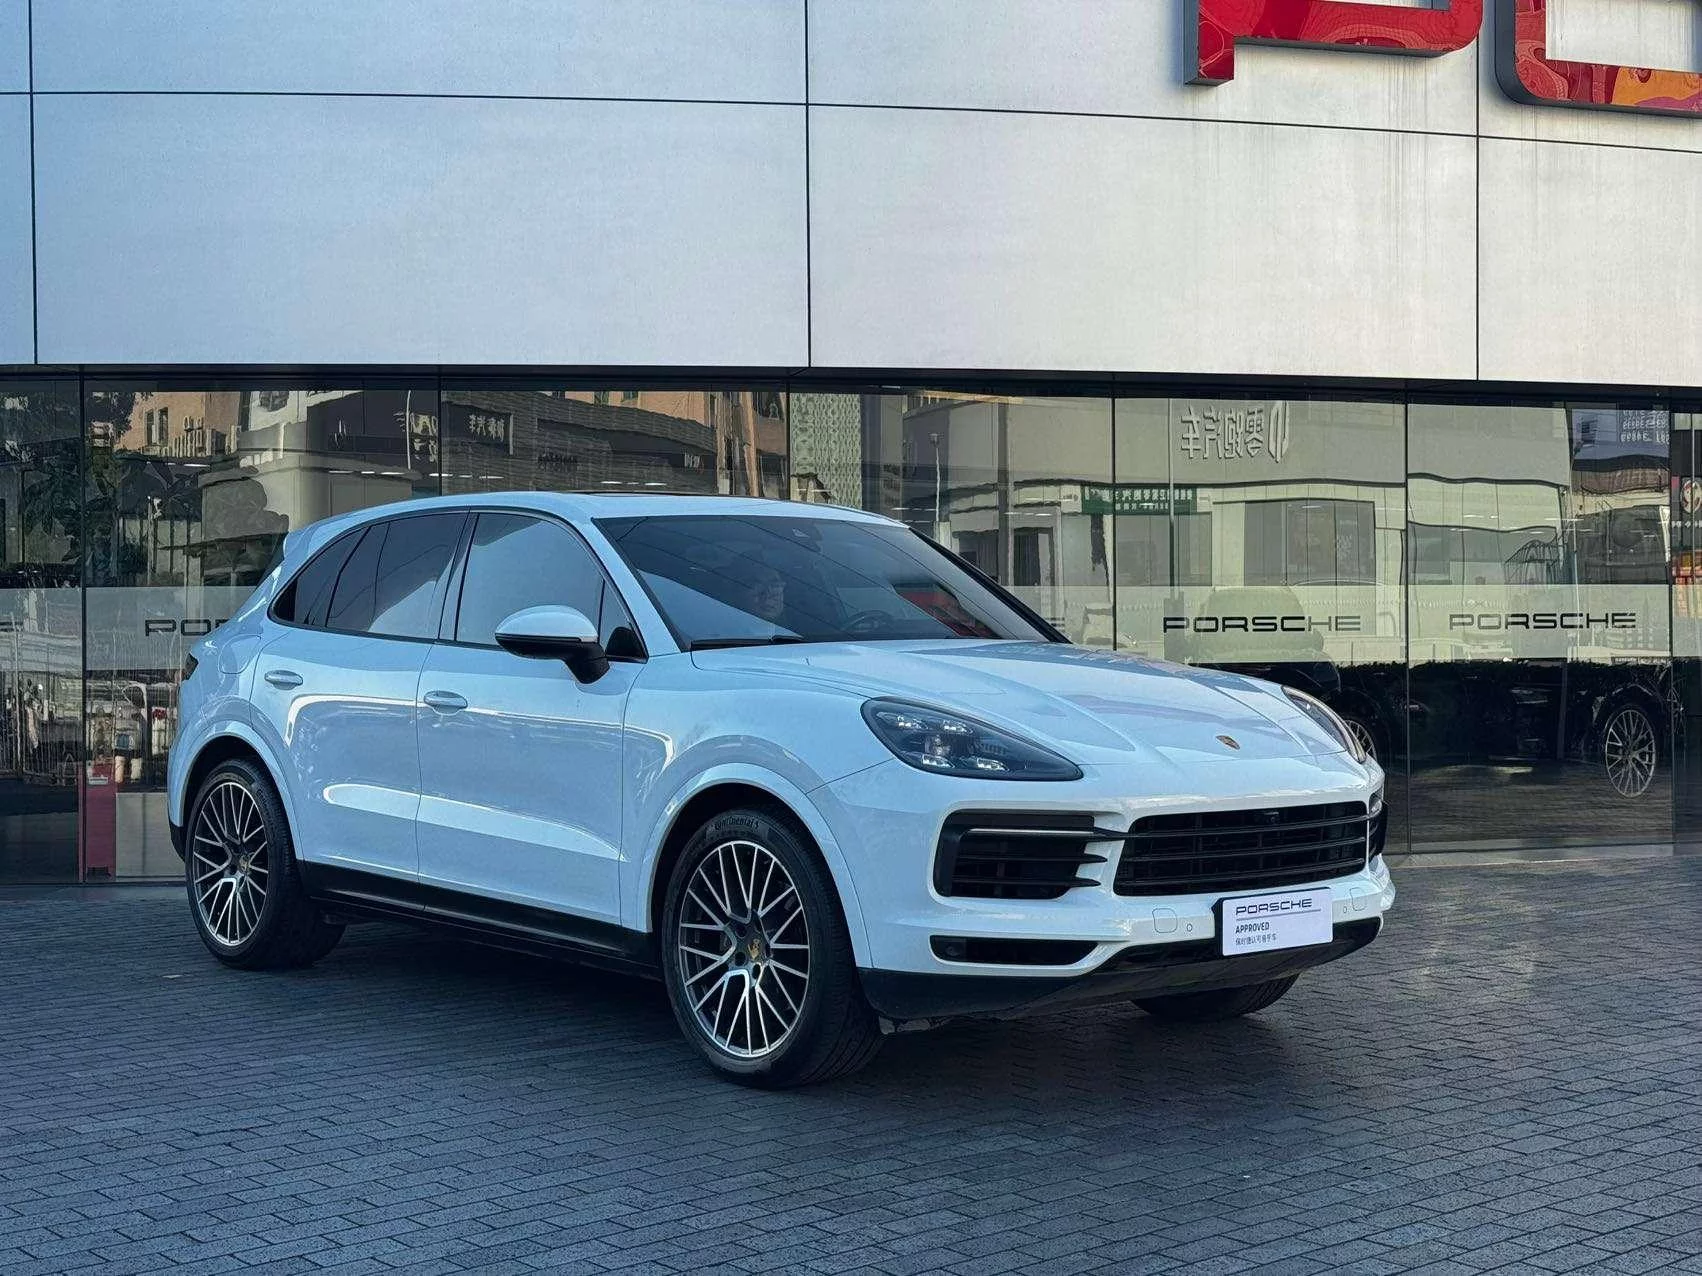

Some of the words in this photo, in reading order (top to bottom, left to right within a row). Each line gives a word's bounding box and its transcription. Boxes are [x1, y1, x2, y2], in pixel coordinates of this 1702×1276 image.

[1163, 616, 1361, 633] PORSCHE
[1450, 613, 1636, 631] PORSCHE
[1236, 899, 1312, 915] PORSCHE
[1236, 922, 1270, 934] APPROVED
